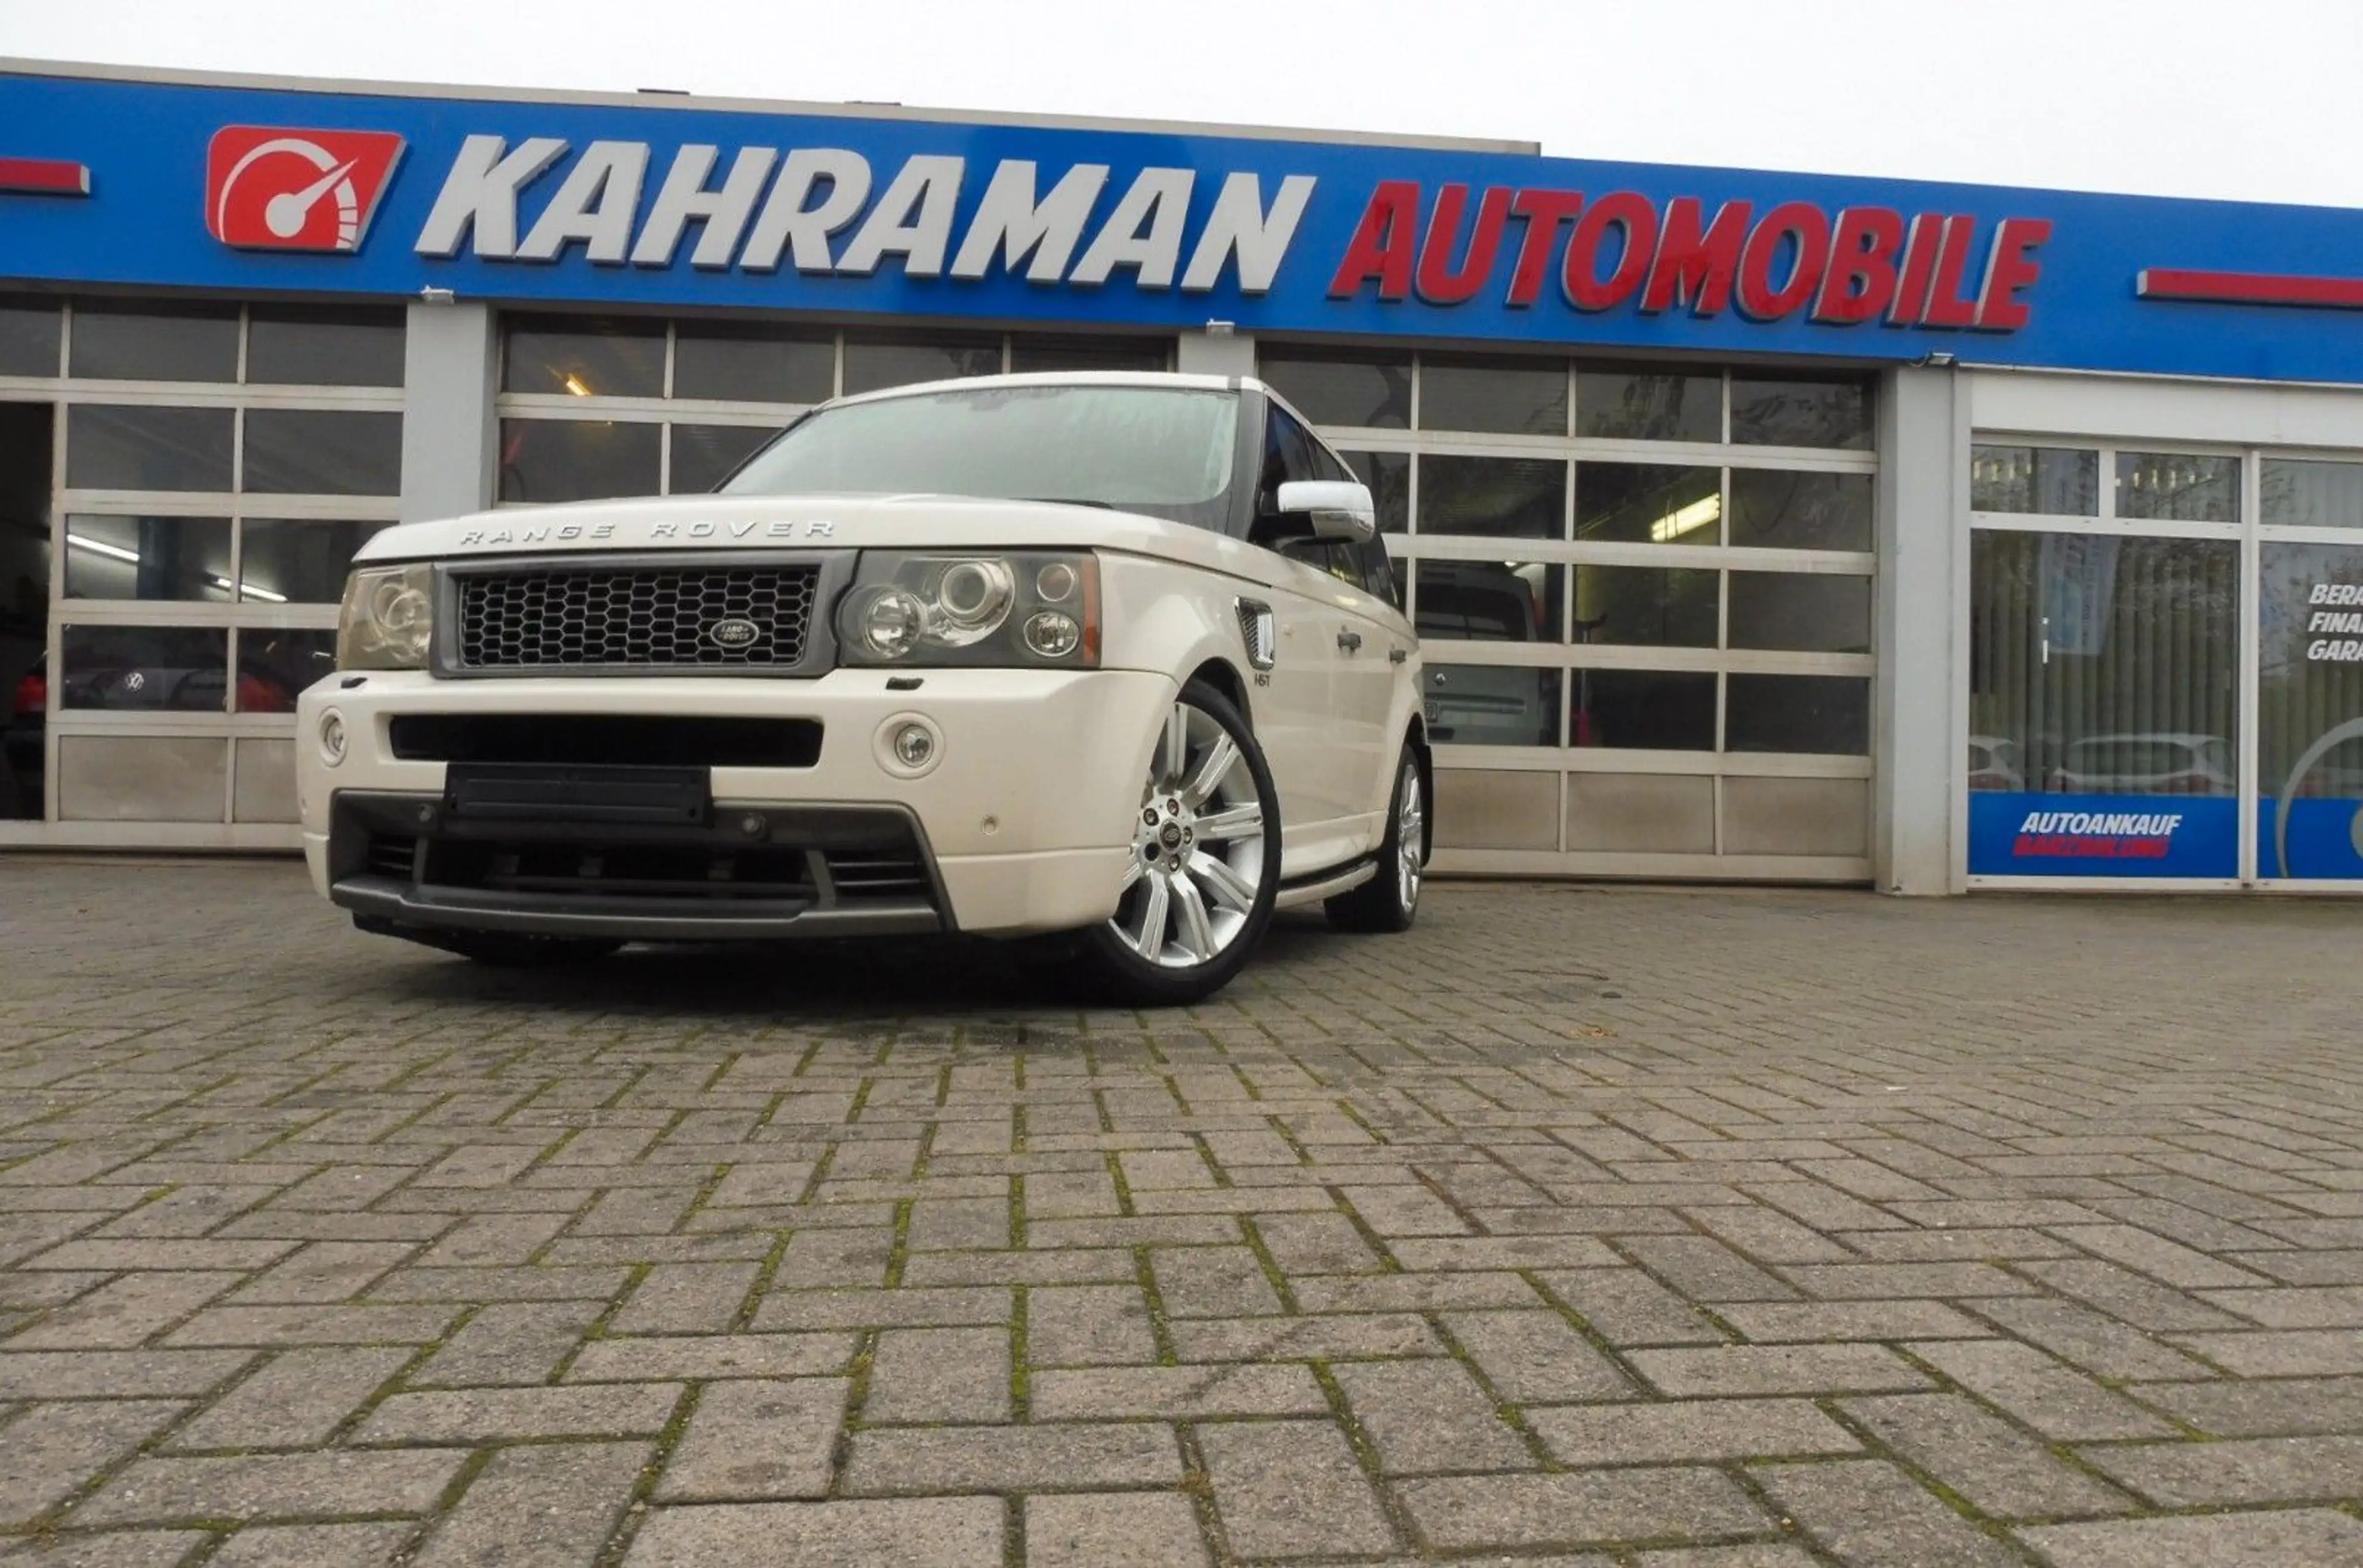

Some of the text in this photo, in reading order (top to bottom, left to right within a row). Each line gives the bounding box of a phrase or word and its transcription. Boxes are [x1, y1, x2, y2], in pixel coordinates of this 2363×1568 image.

[414, 134, 2053, 329] KAHRAMAN AUTOMOBILE
[461, 520, 834, 545] RANGE ROVER
[2308, 611, 2363, 633] FINA
[2020, 812, 2183, 836] AUTOANKAUF
